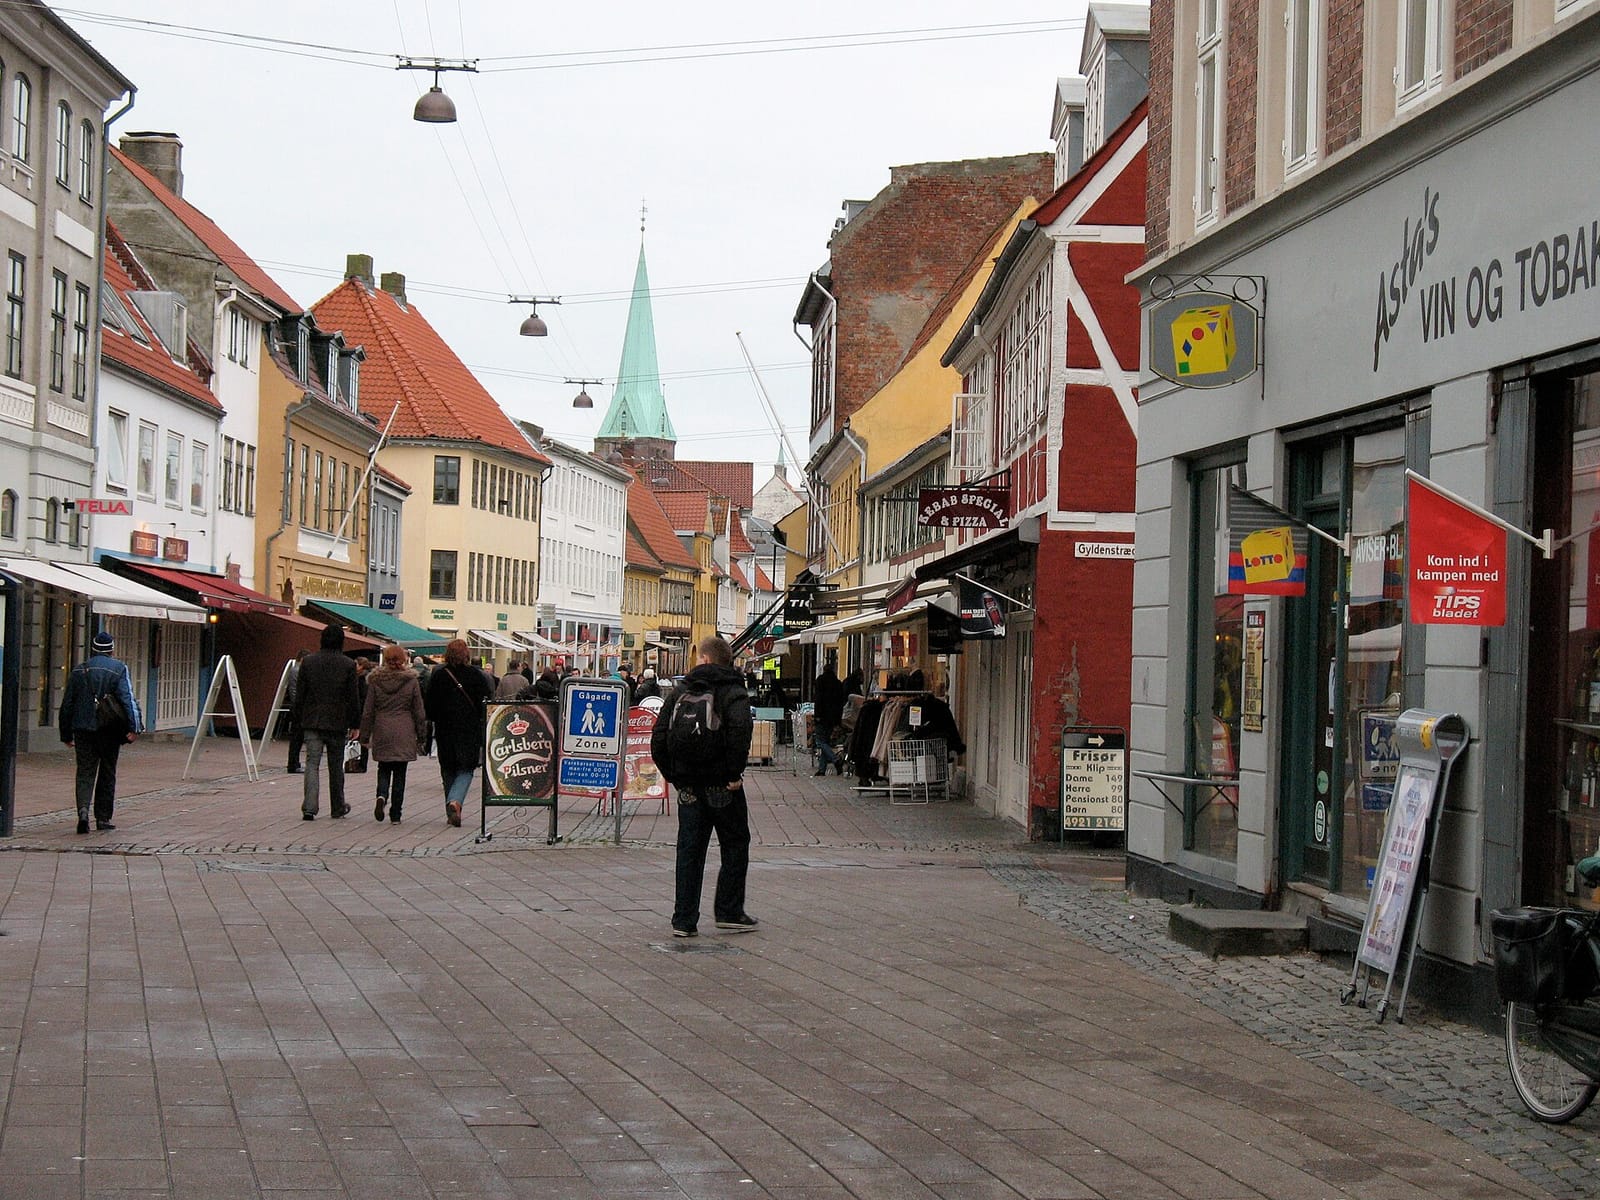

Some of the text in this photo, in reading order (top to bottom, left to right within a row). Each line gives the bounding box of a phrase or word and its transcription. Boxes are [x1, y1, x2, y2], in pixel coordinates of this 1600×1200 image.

[1373, 186, 1440, 373] Asta's
[1420, 276, 1456, 343] VIN
[1466, 258, 1503, 328] OG
[76, 500, 130, 515] TELIA
[919, 493, 1009, 527] KEBAB SPECIAL
[940, 515, 988, 528] & PIZZA
[1245, 554, 1284, 568] LOTTO
[1427, 554, 1489, 567] Kom ind i
[1416, 568, 1499, 583] kampen med
[1433, 595, 1481, 609] TIPS
[1432, 608, 1479, 619] bladet
[578, 691, 612, 702] Gågade
[490, 737, 553, 761] Carlsberg
[575, 738, 607, 749] Zone
[1073, 750, 1117, 762] Frisør
[502, 763, 548, 779] Pilsner
[1086, 764, 1105, 774] Klip
[1065, 774, 1123, 782] Dame 149
[1065, 784, 1123, 793] Herre 99
[1065, 795, 1123, 804] Pensionst 80
[1065, 805, 1123, 813] Børn 80
[1065, 817, 1091, 827] 4921
